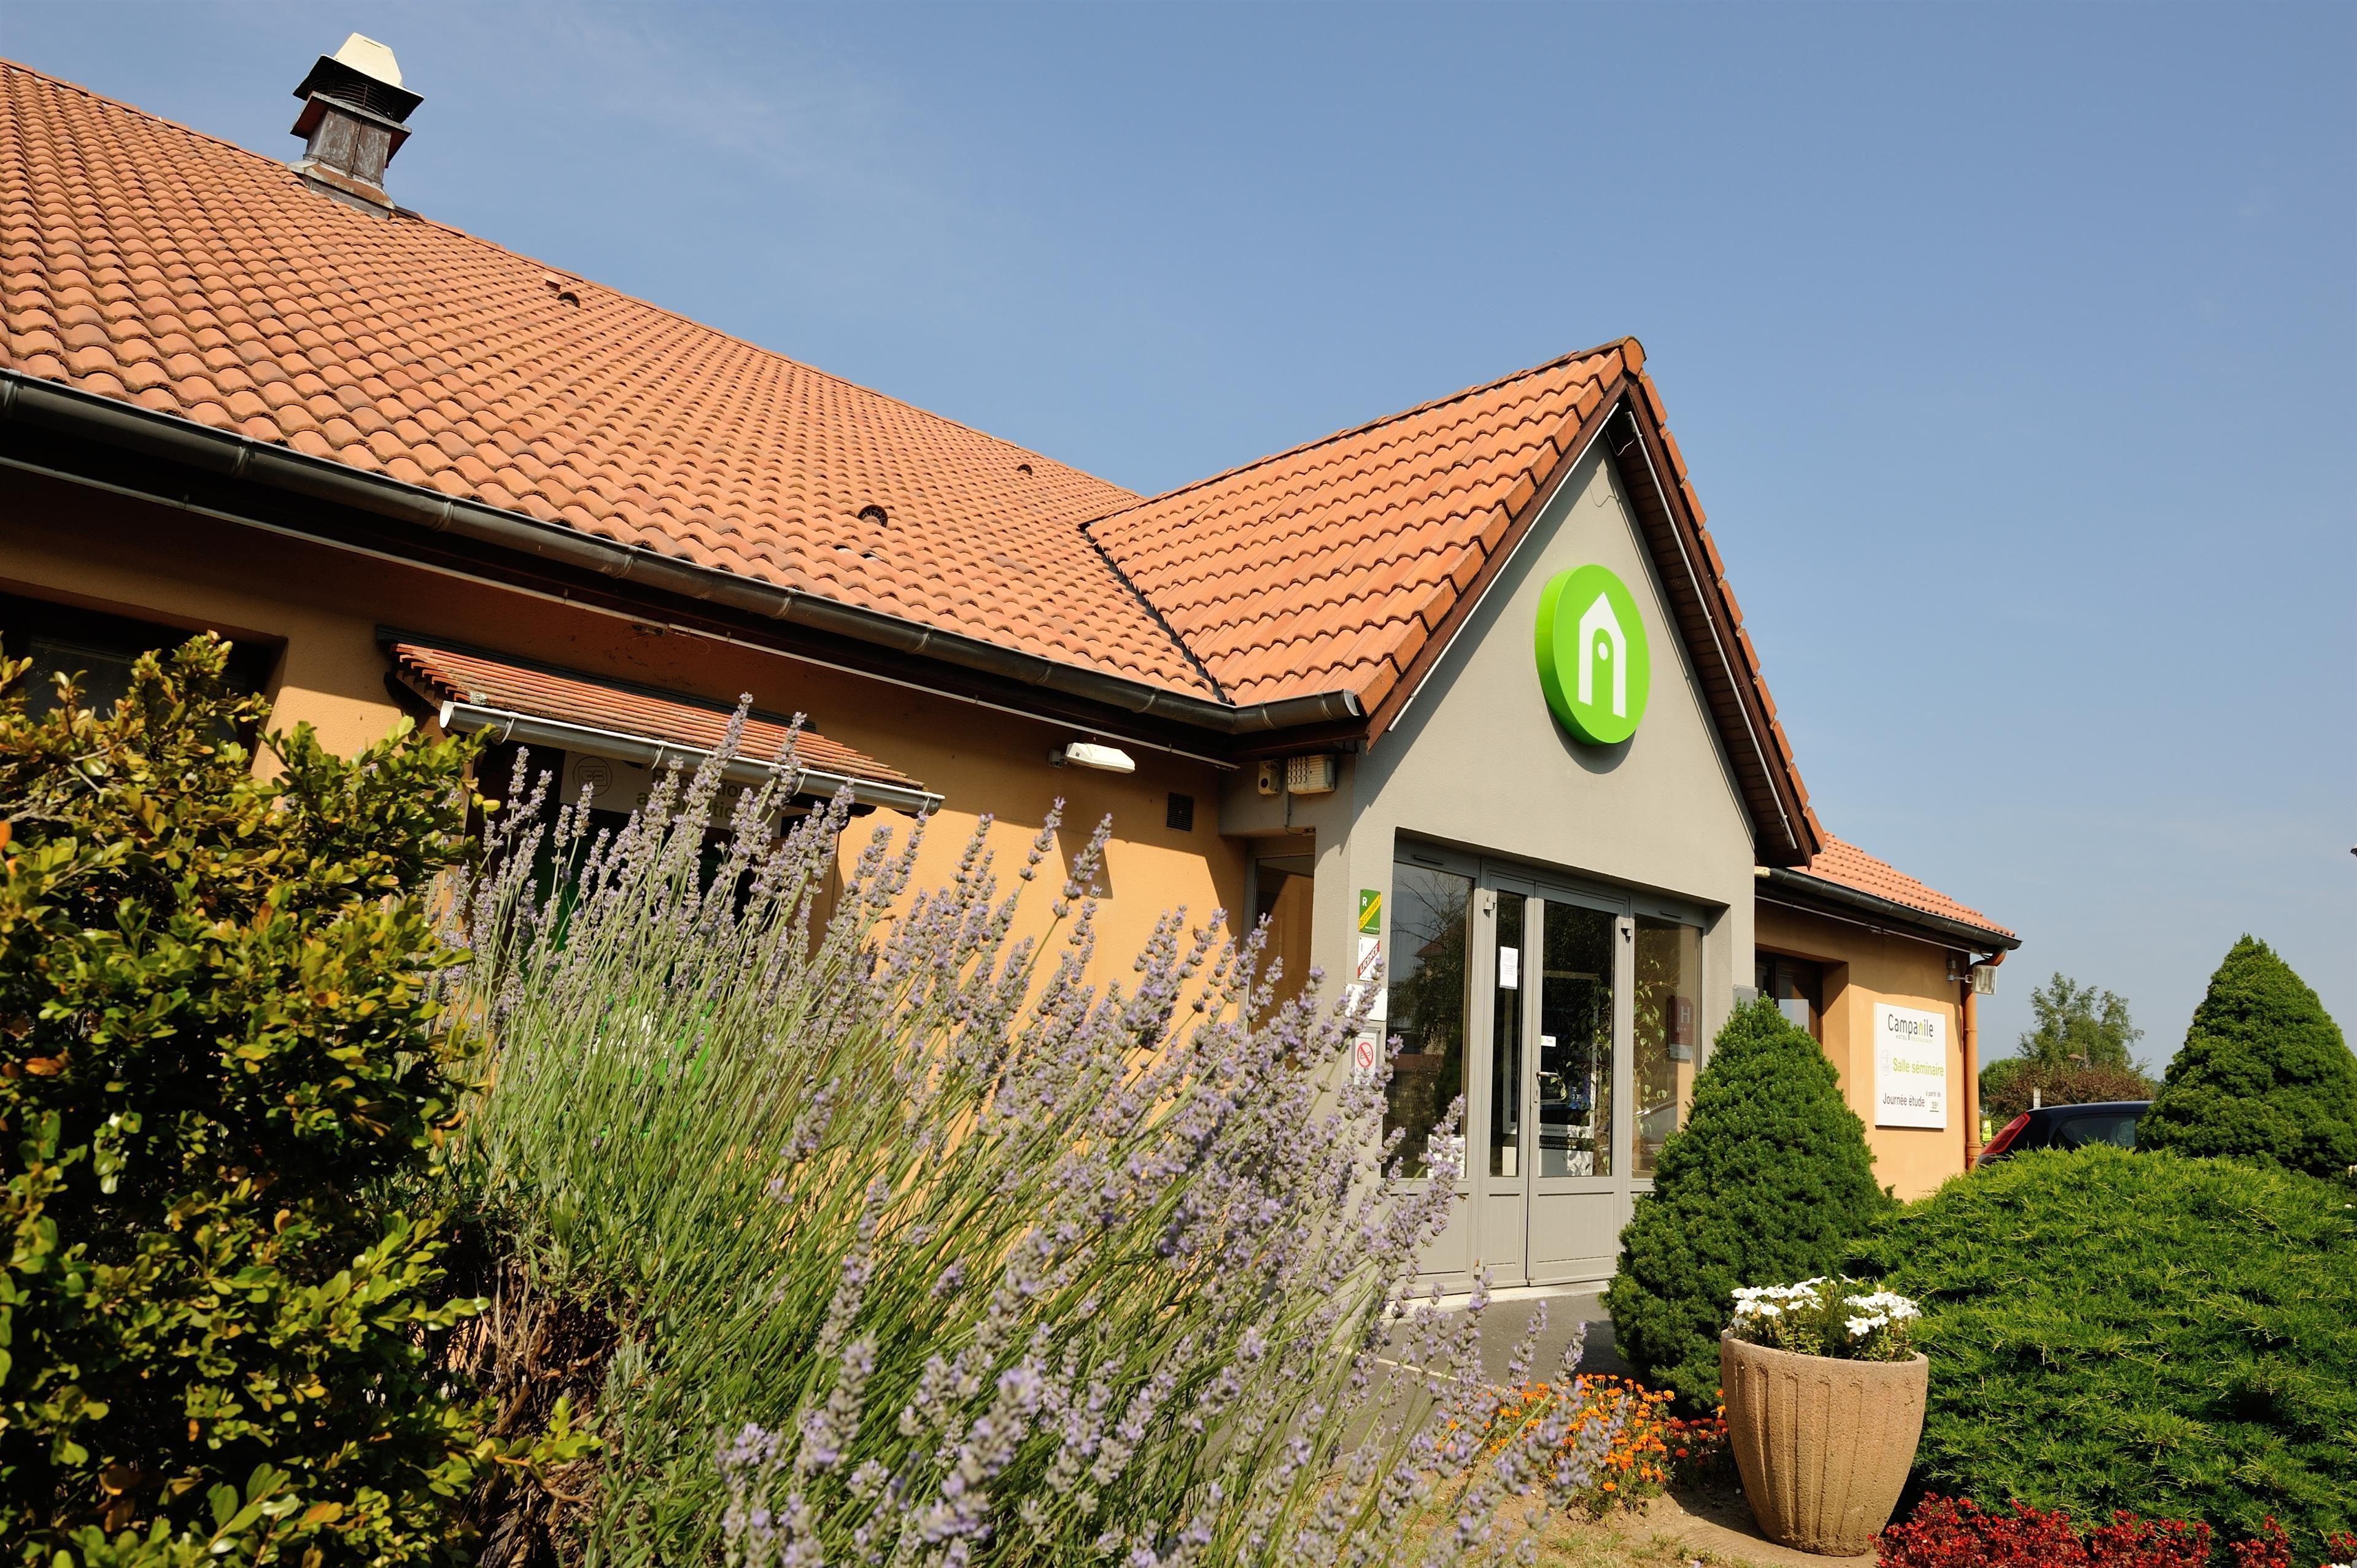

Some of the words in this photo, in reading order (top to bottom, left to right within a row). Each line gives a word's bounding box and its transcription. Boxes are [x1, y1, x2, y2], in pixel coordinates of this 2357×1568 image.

[1362, 897, 1368, 906] R
[1360, 944, 1378, 973] LICENCE
[1681, 1006, 1690, 1024] H
[1888, 1013, 1933, 1041] Campanile
[1893, 1057, 1910, 1073] Salle
[1911, 1060, 1944, 1076] séminaire
[1883, 1092, 1907, 1106] Journée
[1909, 1094, 1925, 1107] étude
